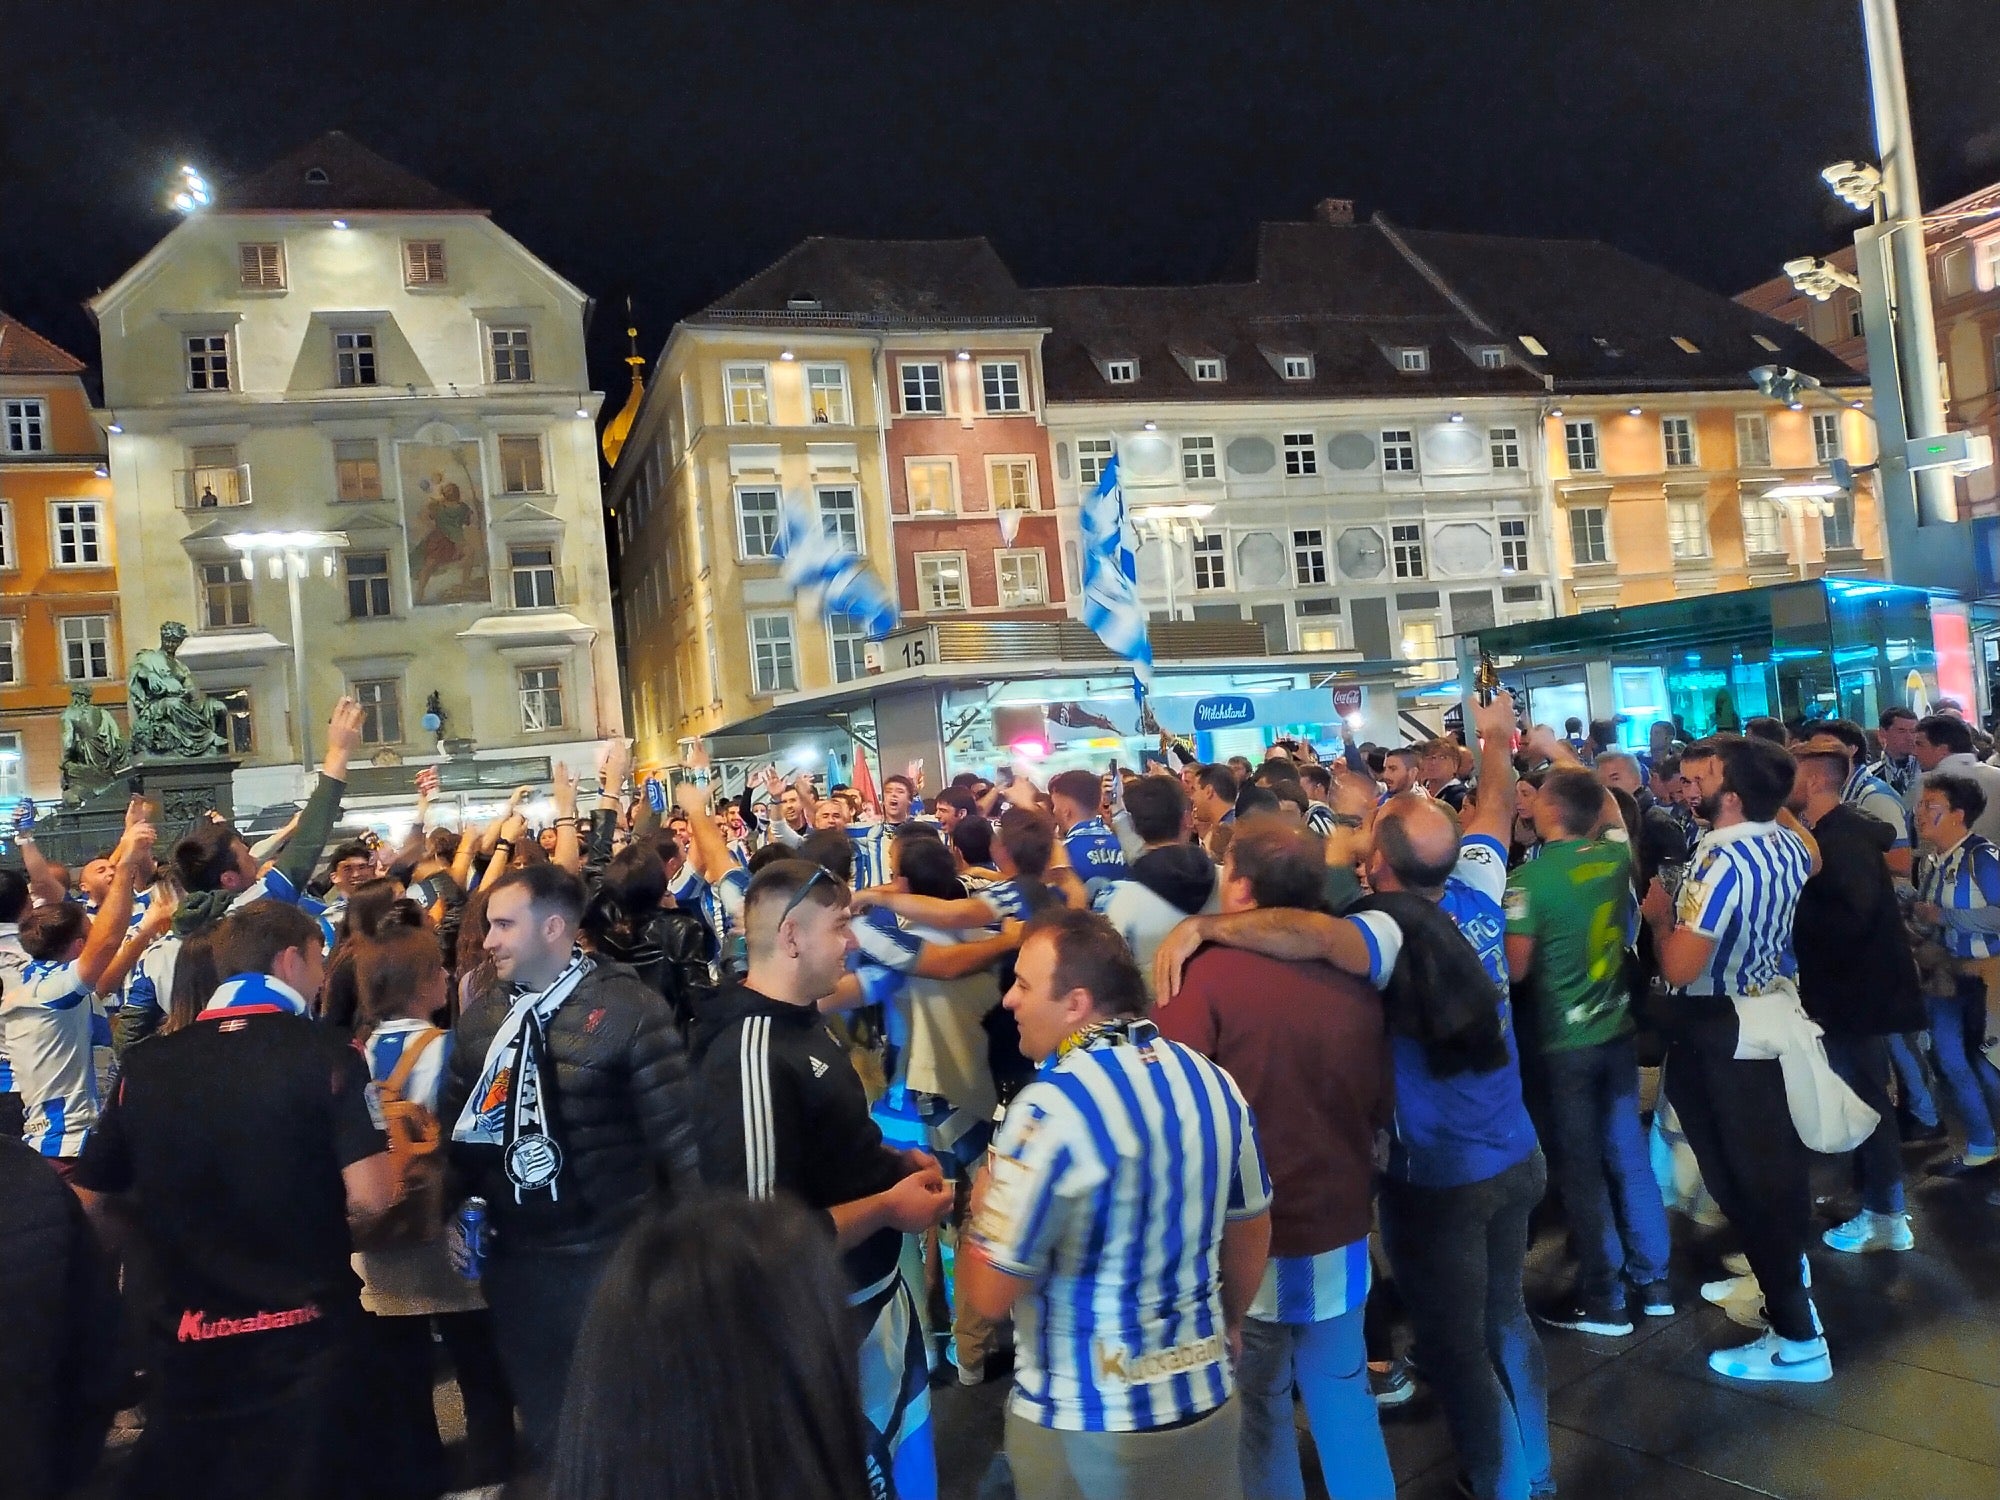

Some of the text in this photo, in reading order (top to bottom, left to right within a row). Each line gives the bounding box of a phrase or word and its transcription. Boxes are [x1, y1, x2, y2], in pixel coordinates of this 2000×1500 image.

[902, 641, 926, 668] 15
[1198, 702, 1247, 720] Milchstand
[1086, 848, 1125, 866] SILVA
